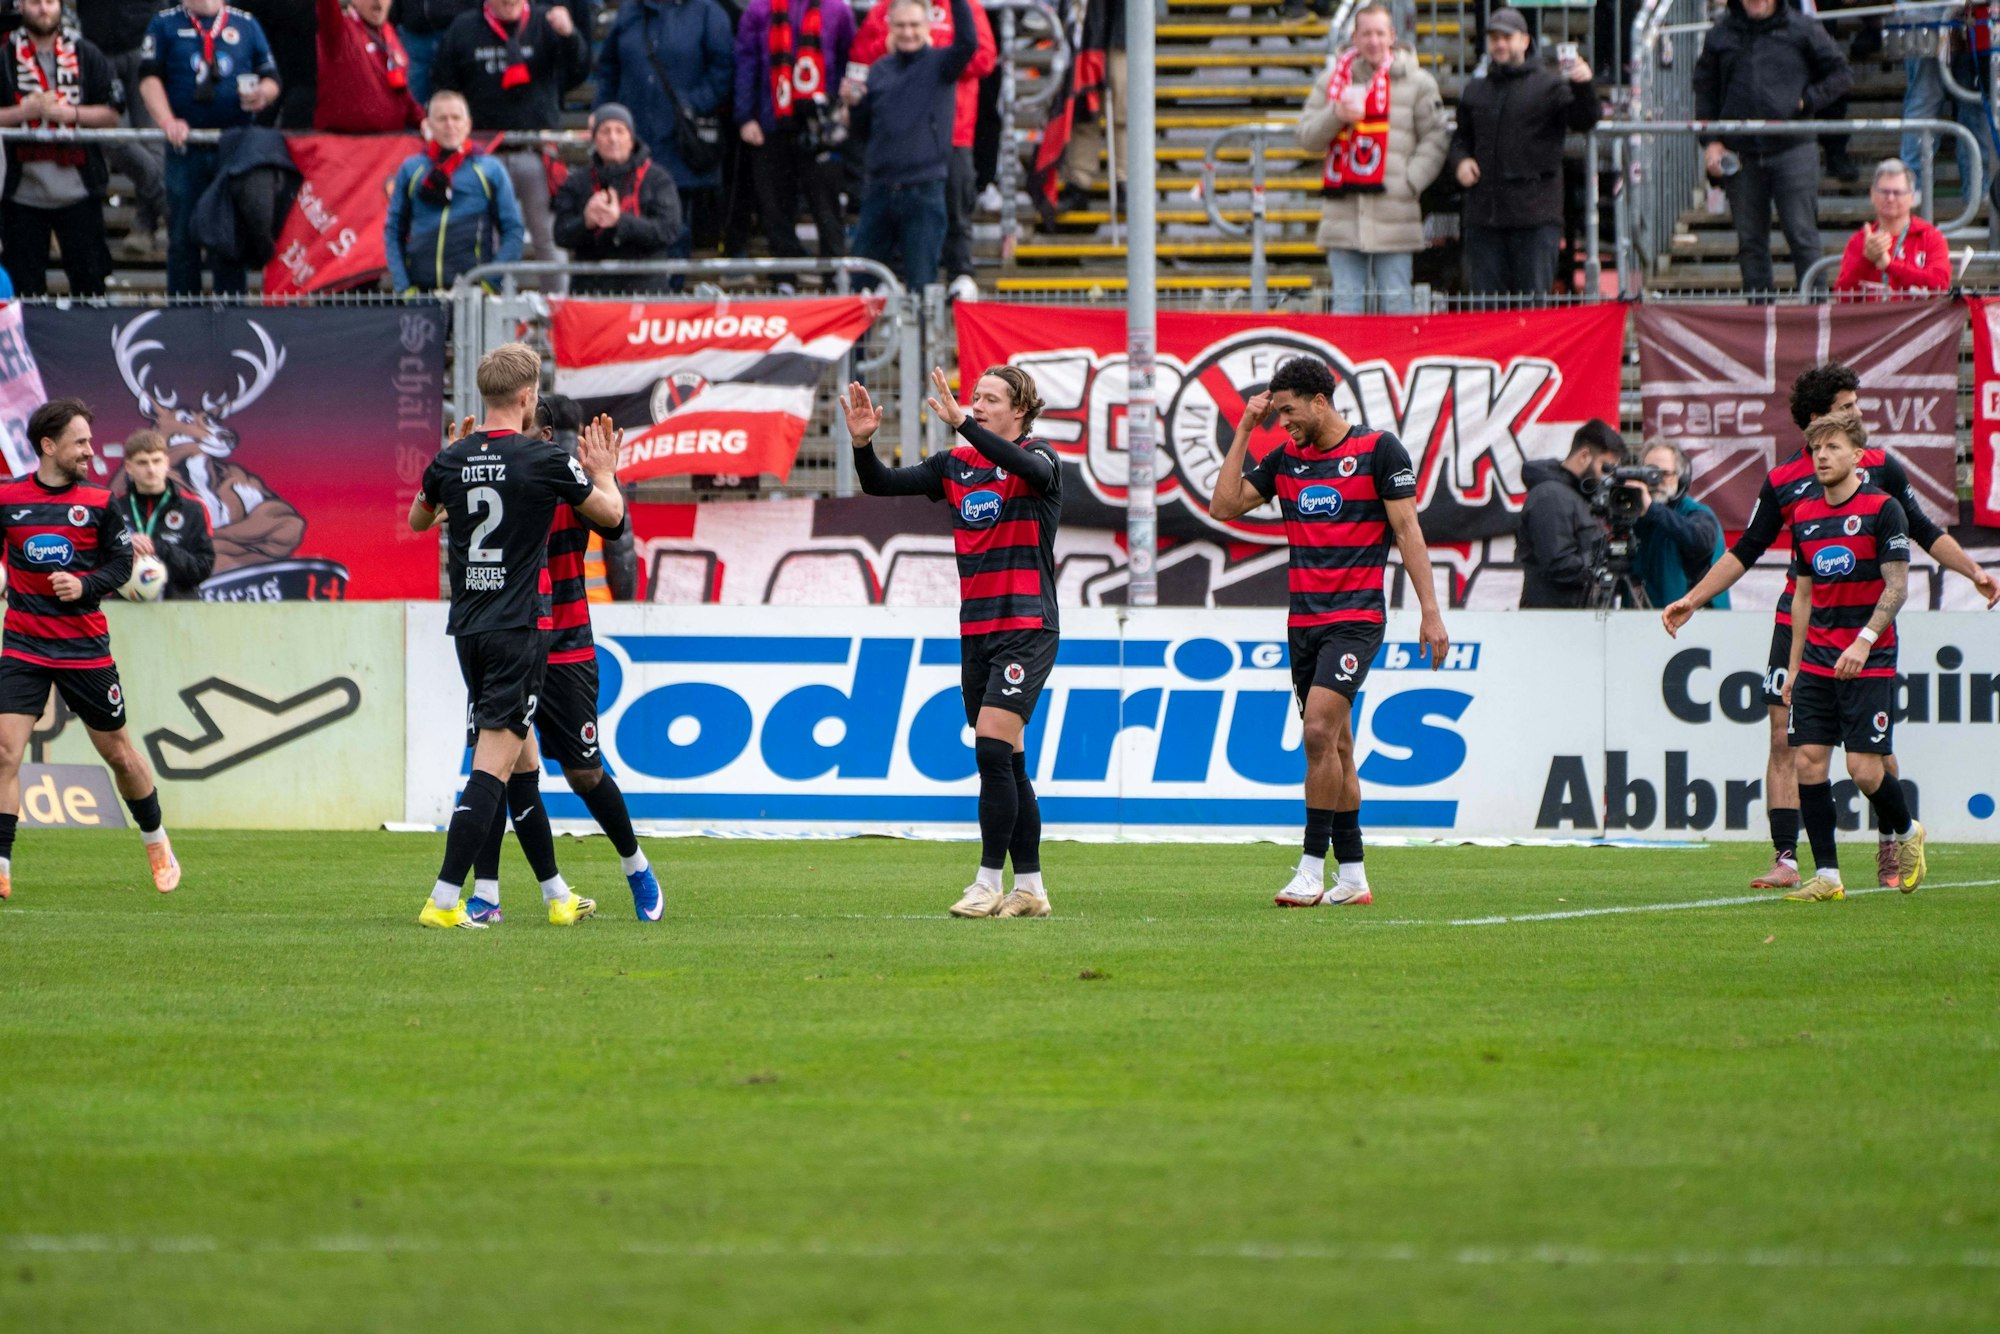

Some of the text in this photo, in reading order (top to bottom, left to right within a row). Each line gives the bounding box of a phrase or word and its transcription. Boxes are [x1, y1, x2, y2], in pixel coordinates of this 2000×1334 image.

[626, 314, 789, 345] JUNIORS
[391, 313, 436, 431] Schäl
[461, 464, 506, 483] DIETZ
[467, 486, 504, 562] 2
[1250, 643, 1476, 670] GbH
[522, 694, 538, 728] 2
[18, 773, 101, 826] de
[1534, 750, 1919, 832] Abbrc
